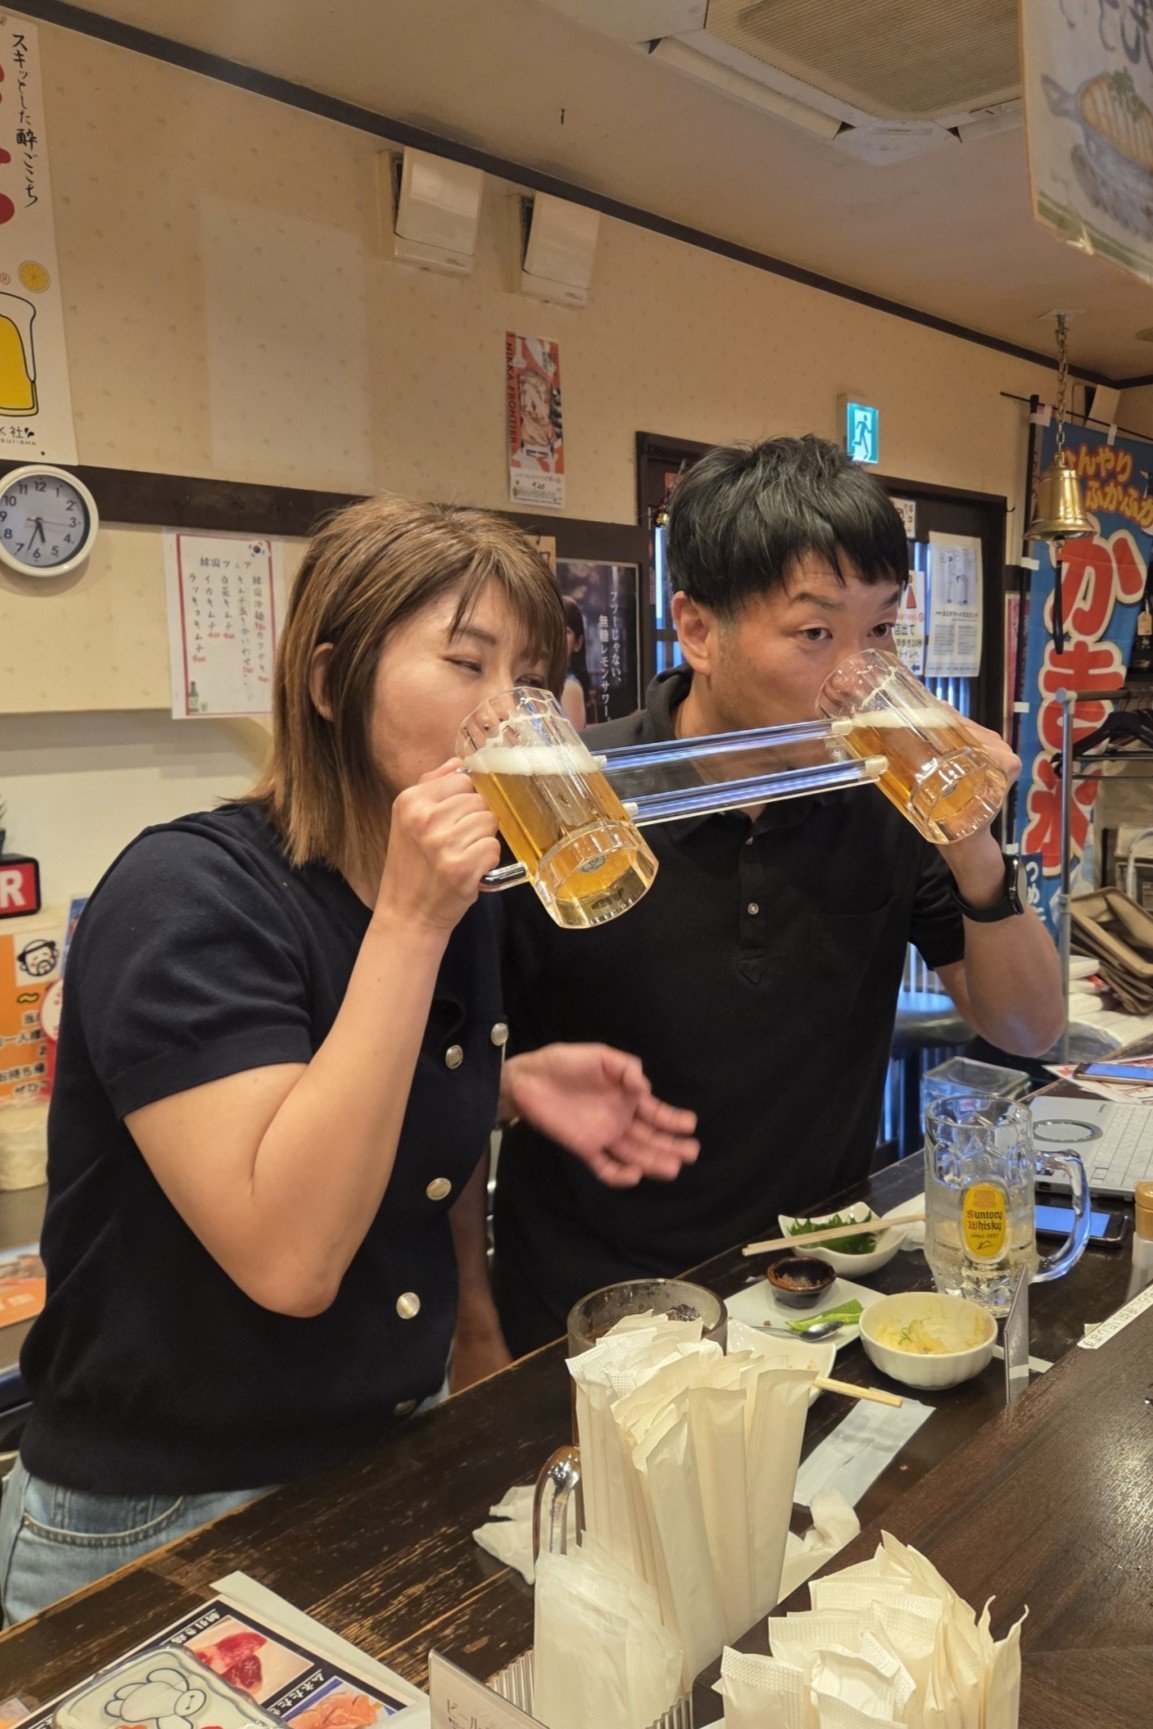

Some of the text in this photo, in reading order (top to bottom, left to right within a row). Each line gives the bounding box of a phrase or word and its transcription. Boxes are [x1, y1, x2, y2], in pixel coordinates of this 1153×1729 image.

[507, 385, 517, 444] FRONTIER
[19, 484, 28, 495] 11
[34, 481, 47, 492] 12
[55, 486, 60, 498] 1
[3, 495, 17, 507] 10
[65, 500, 76, 511] 2
[69, 517, 77, 528] 3
[4, 528, 13, 539] 8
[64, 534, 71, 543] 4
[16, 542, 24, 553] 7
[33, 548, 41, 558] 6
[51, 545, 59, 556] 5
[966, 1210, 1002, 1220] Suntory
[968, 1221, 1001, 1231] Whisky
